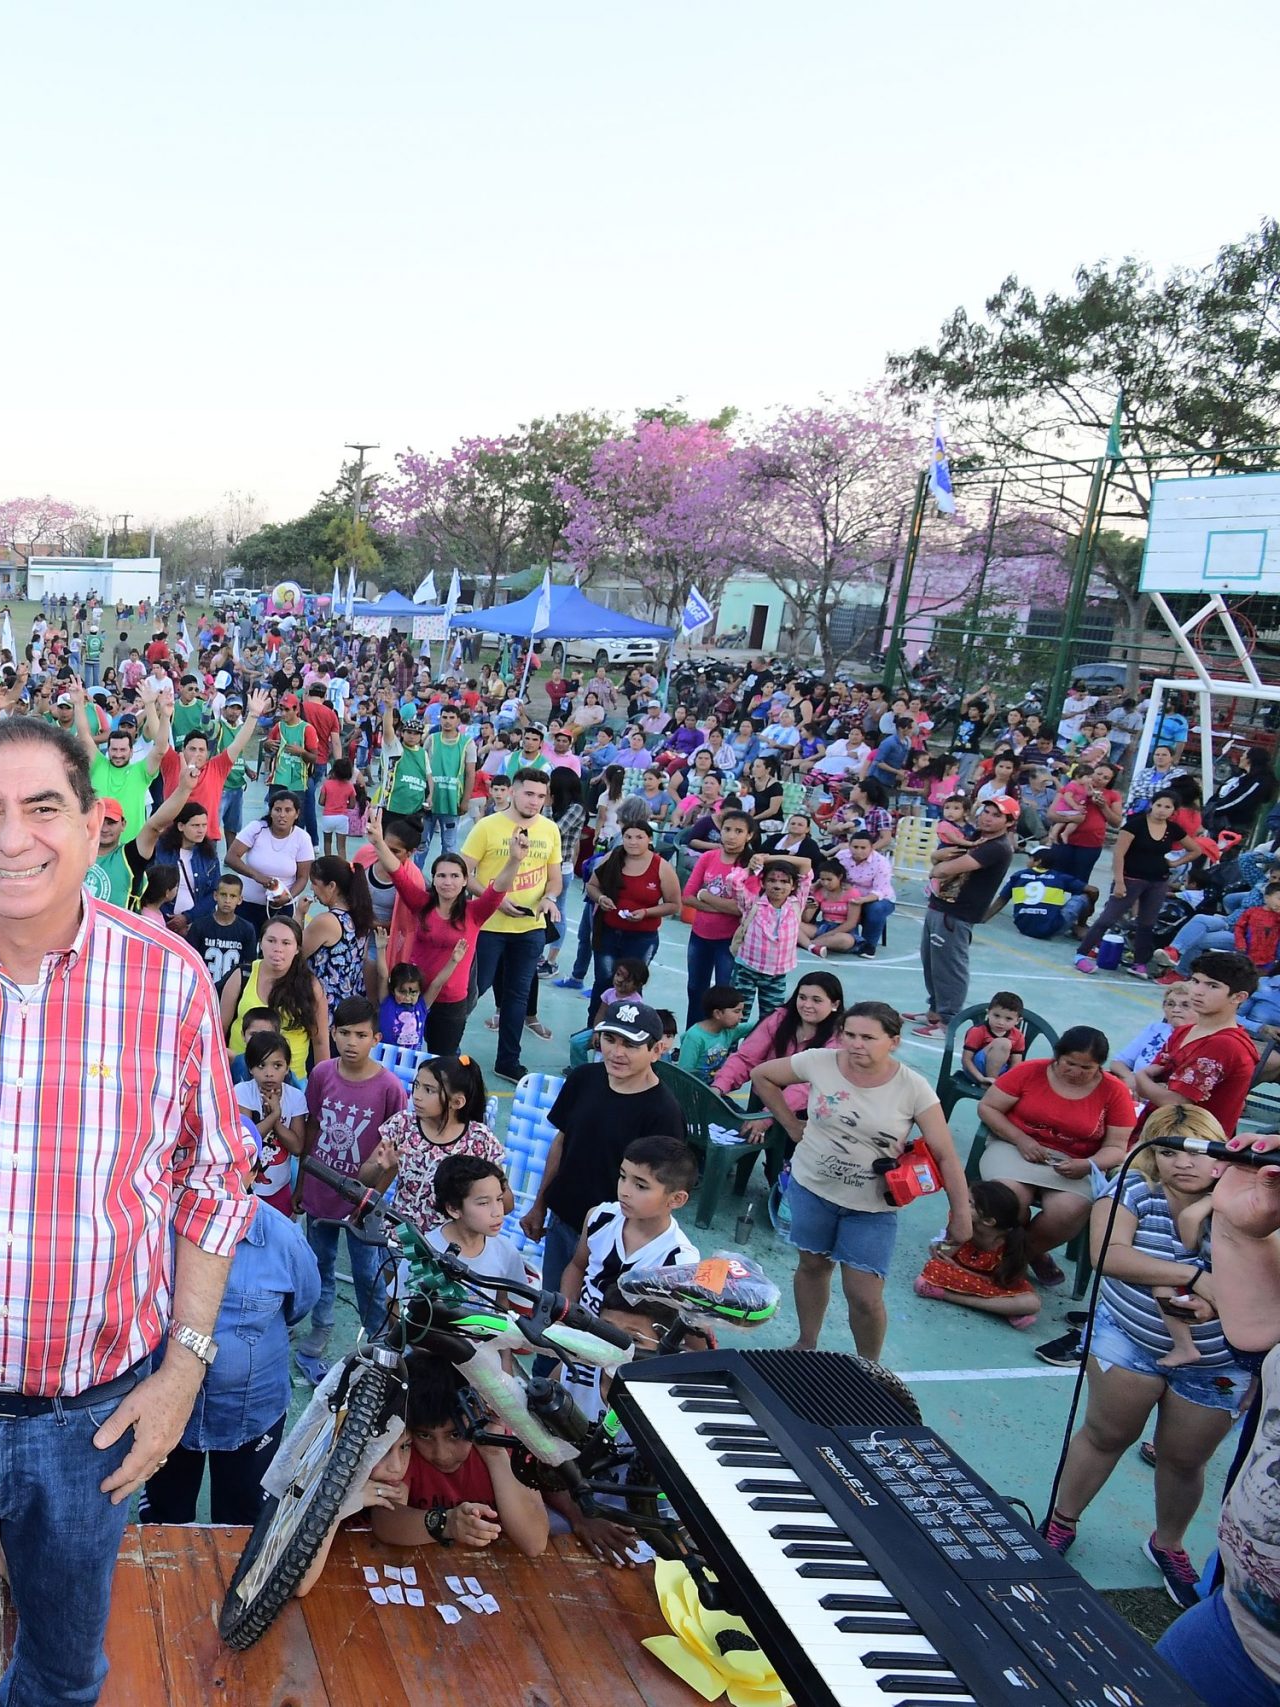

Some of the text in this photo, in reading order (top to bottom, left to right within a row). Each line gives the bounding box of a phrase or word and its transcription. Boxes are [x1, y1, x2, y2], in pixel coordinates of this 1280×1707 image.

[1023, 881, 1046, 905] 9
[820, 1446, 880, 1507] Roland E-14
